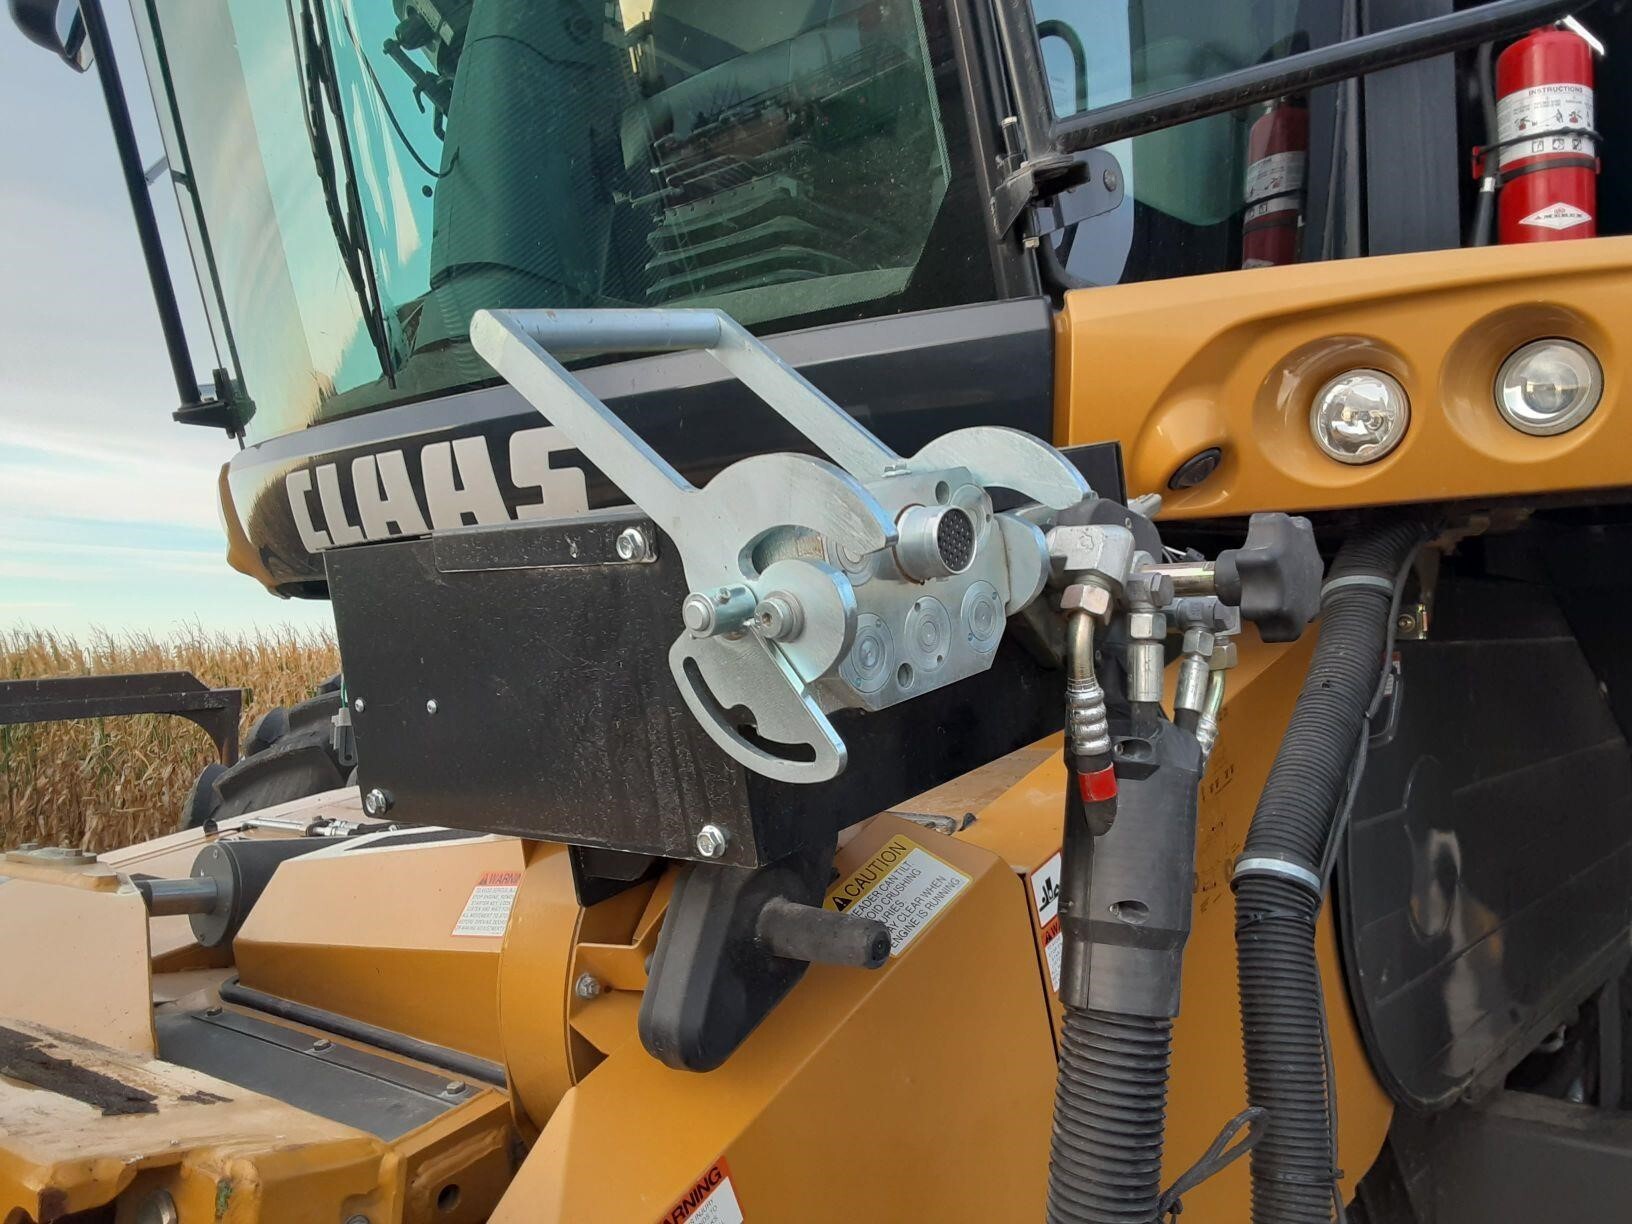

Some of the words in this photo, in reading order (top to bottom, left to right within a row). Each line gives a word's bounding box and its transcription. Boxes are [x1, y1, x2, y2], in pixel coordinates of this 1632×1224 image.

[1529, 86, 1583, 97] INSTRUCTIONS
[285, 425, 590, 554] CLAAS
[844, 841, 907, 898] CAUTION
[850, 890, 881, 919] EADER
[879, 876, 896, 893] CAN
[895, 860, 914, 878] TILT
[881, 868, 922, 907] CRUSHING
[896, 896, 925, 922] CLEAR
[921, 875, 946, 901] WHEN
[918, 909, 929, 920] IS
[924, 877, 960, 912] RUNNING
